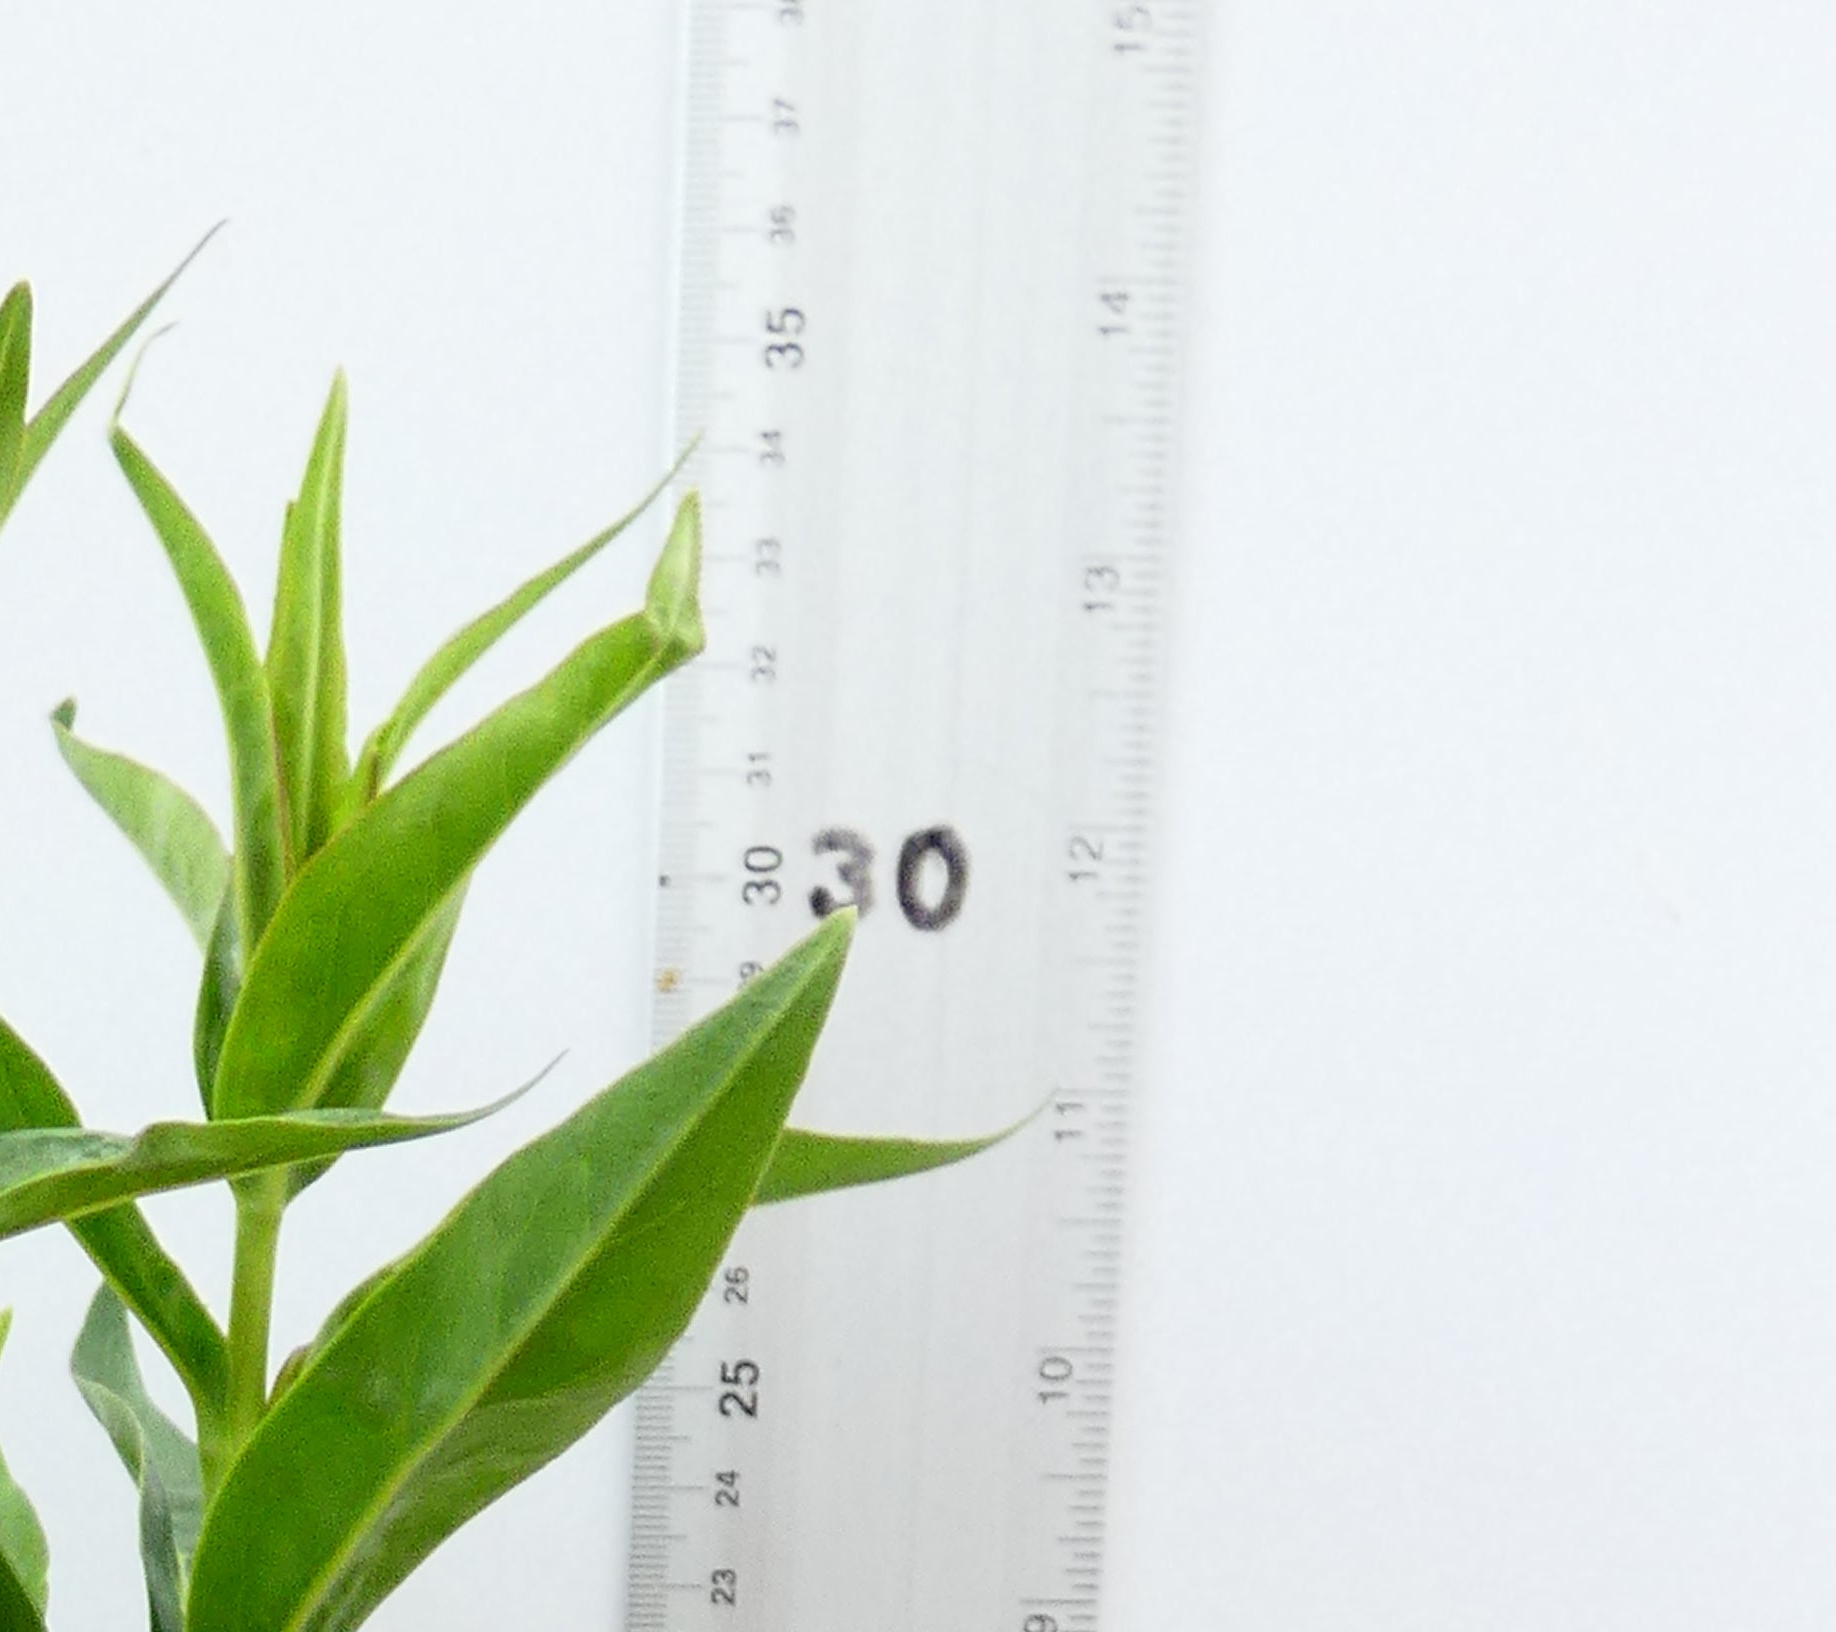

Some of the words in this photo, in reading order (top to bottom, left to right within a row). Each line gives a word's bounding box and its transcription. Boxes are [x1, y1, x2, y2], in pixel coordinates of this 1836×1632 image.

[771, 99, 799, 136] 37
[768, 204, 797, 246] 36
[1097, 291, 1131, 335] 14
[764, 308, 806, 370] 35
[758, 430, 786, 466] 34
[754, 538, 782, 578] 33
[1081, 566, 1121, 614] 13
[750, 645, 776, 682] 32
[746, 752, 772, 787] 31
[742, 845, 782, 906] 30
[809, 826, 970, 933] 30
[1069, 837, 1104, 881] 12
[723, 1266, 750, 1305] 26
[718, 1359, 760, 1418] 25
[1037, 1356, 1073, 1405] 10
[715, 1471, 741, 1508] 24
[710, 1569, 738, 1606] 23
